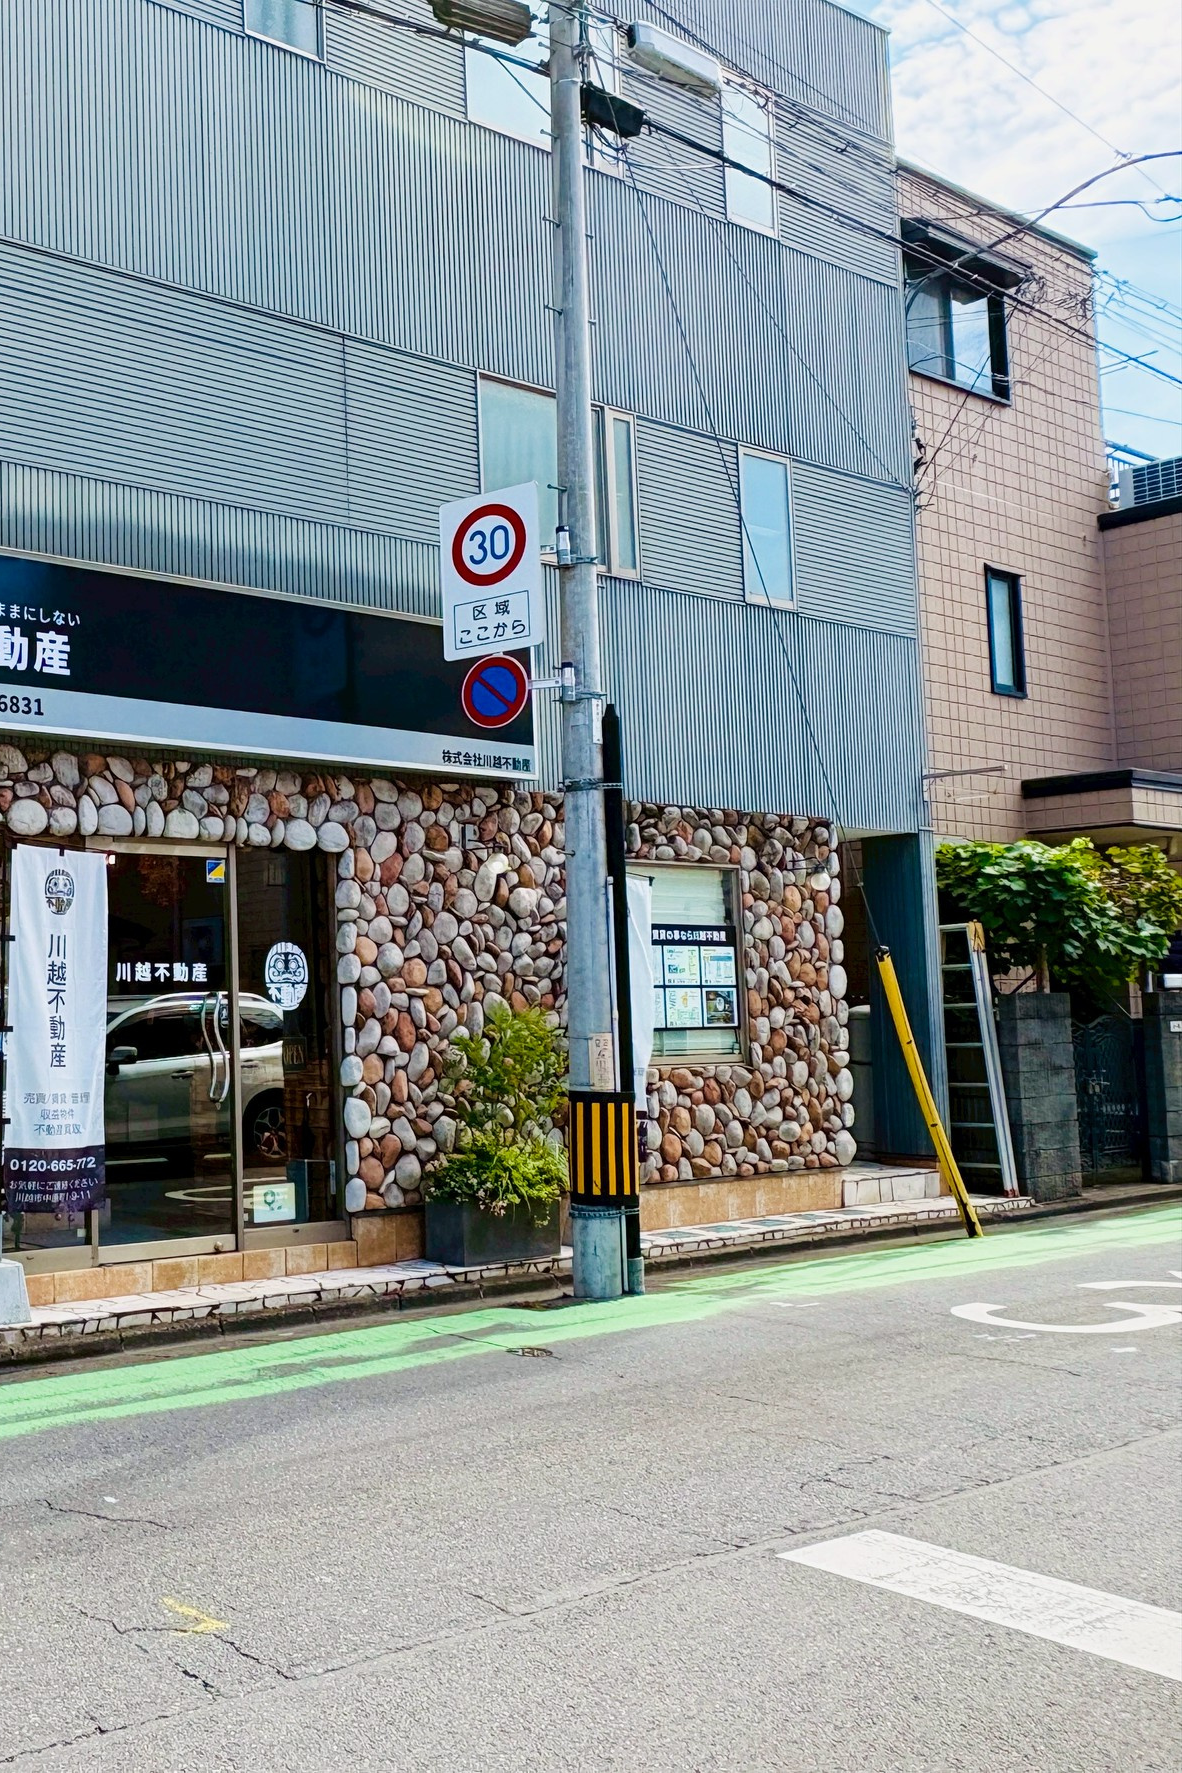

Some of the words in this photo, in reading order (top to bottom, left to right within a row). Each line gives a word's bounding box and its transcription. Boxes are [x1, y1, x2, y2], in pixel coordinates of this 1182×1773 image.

[469, 524, 510, 565] 30
[472, 599, 511, 621] 区域
[459, 619, 526, 645] ここから
[442, 749, 531, 772] 株式会社川越不動産
[116, 962, 208, 983] 川越不動産
[46, 933, 67, 1068] 川越不動産
